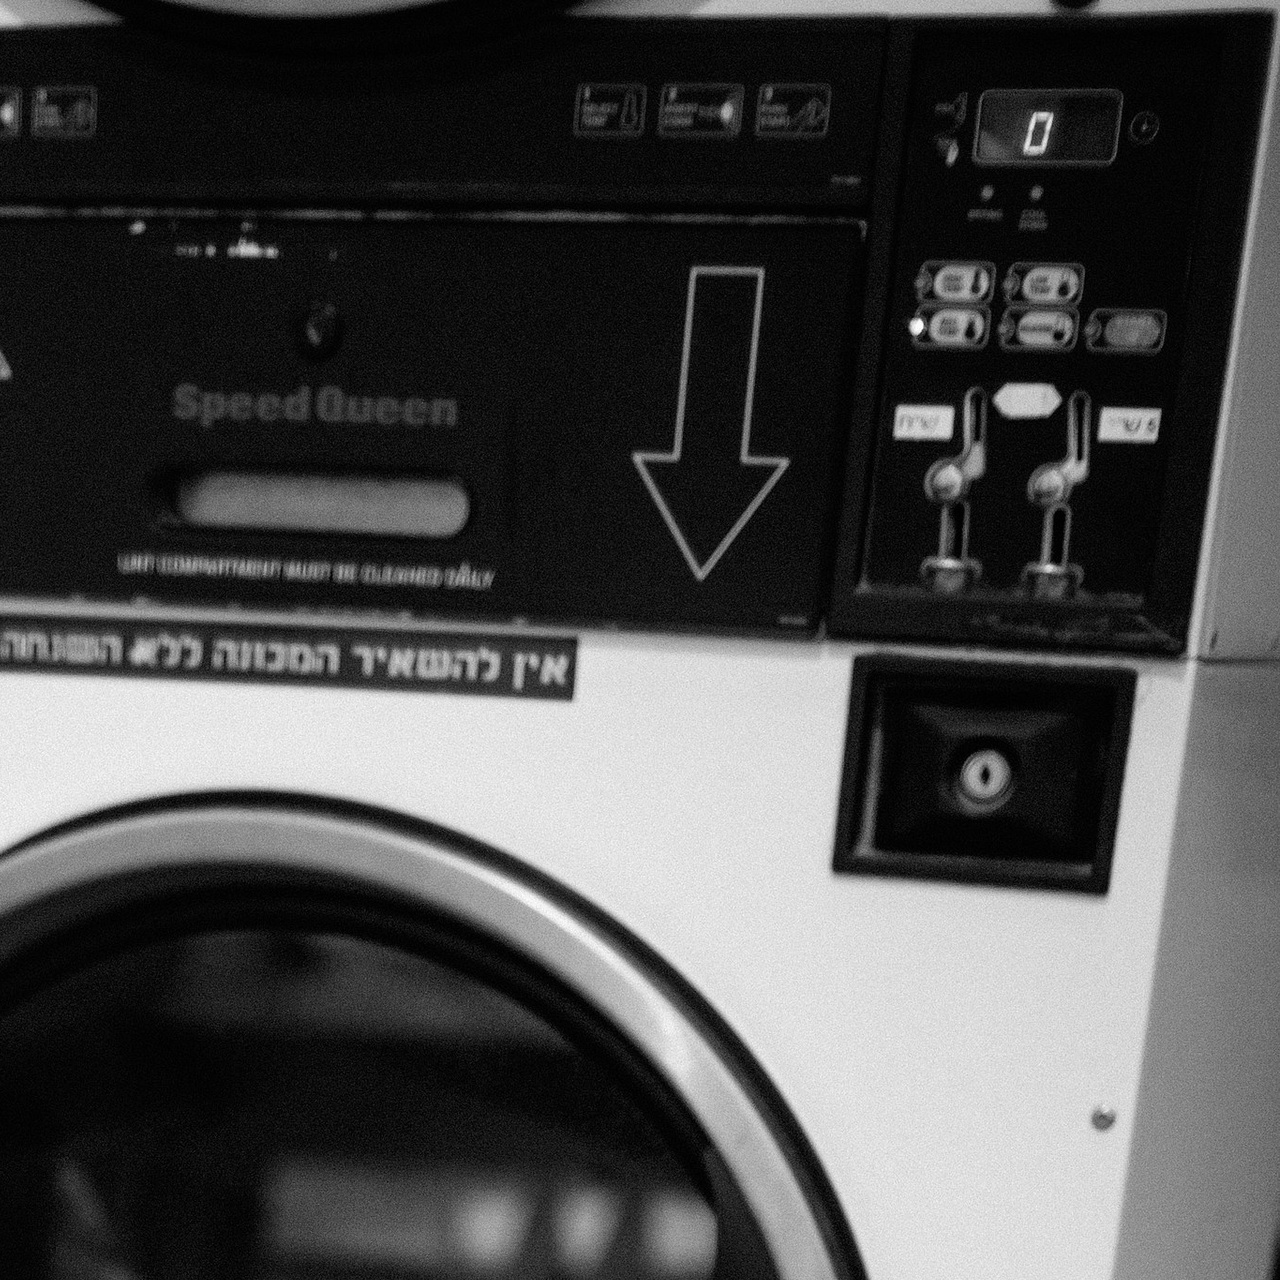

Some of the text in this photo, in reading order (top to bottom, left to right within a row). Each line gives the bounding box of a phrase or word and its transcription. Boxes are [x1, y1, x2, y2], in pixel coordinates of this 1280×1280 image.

[1022, 110, 1056, 156] 0
[172, 382, 458, 428] Speed Queen
[128, 632, 203, 669] ללא
[211, 637, 338, 676] המכונה
[352, 643, 499, 681] להשאיר
[511, 649, 570, 691] אין
